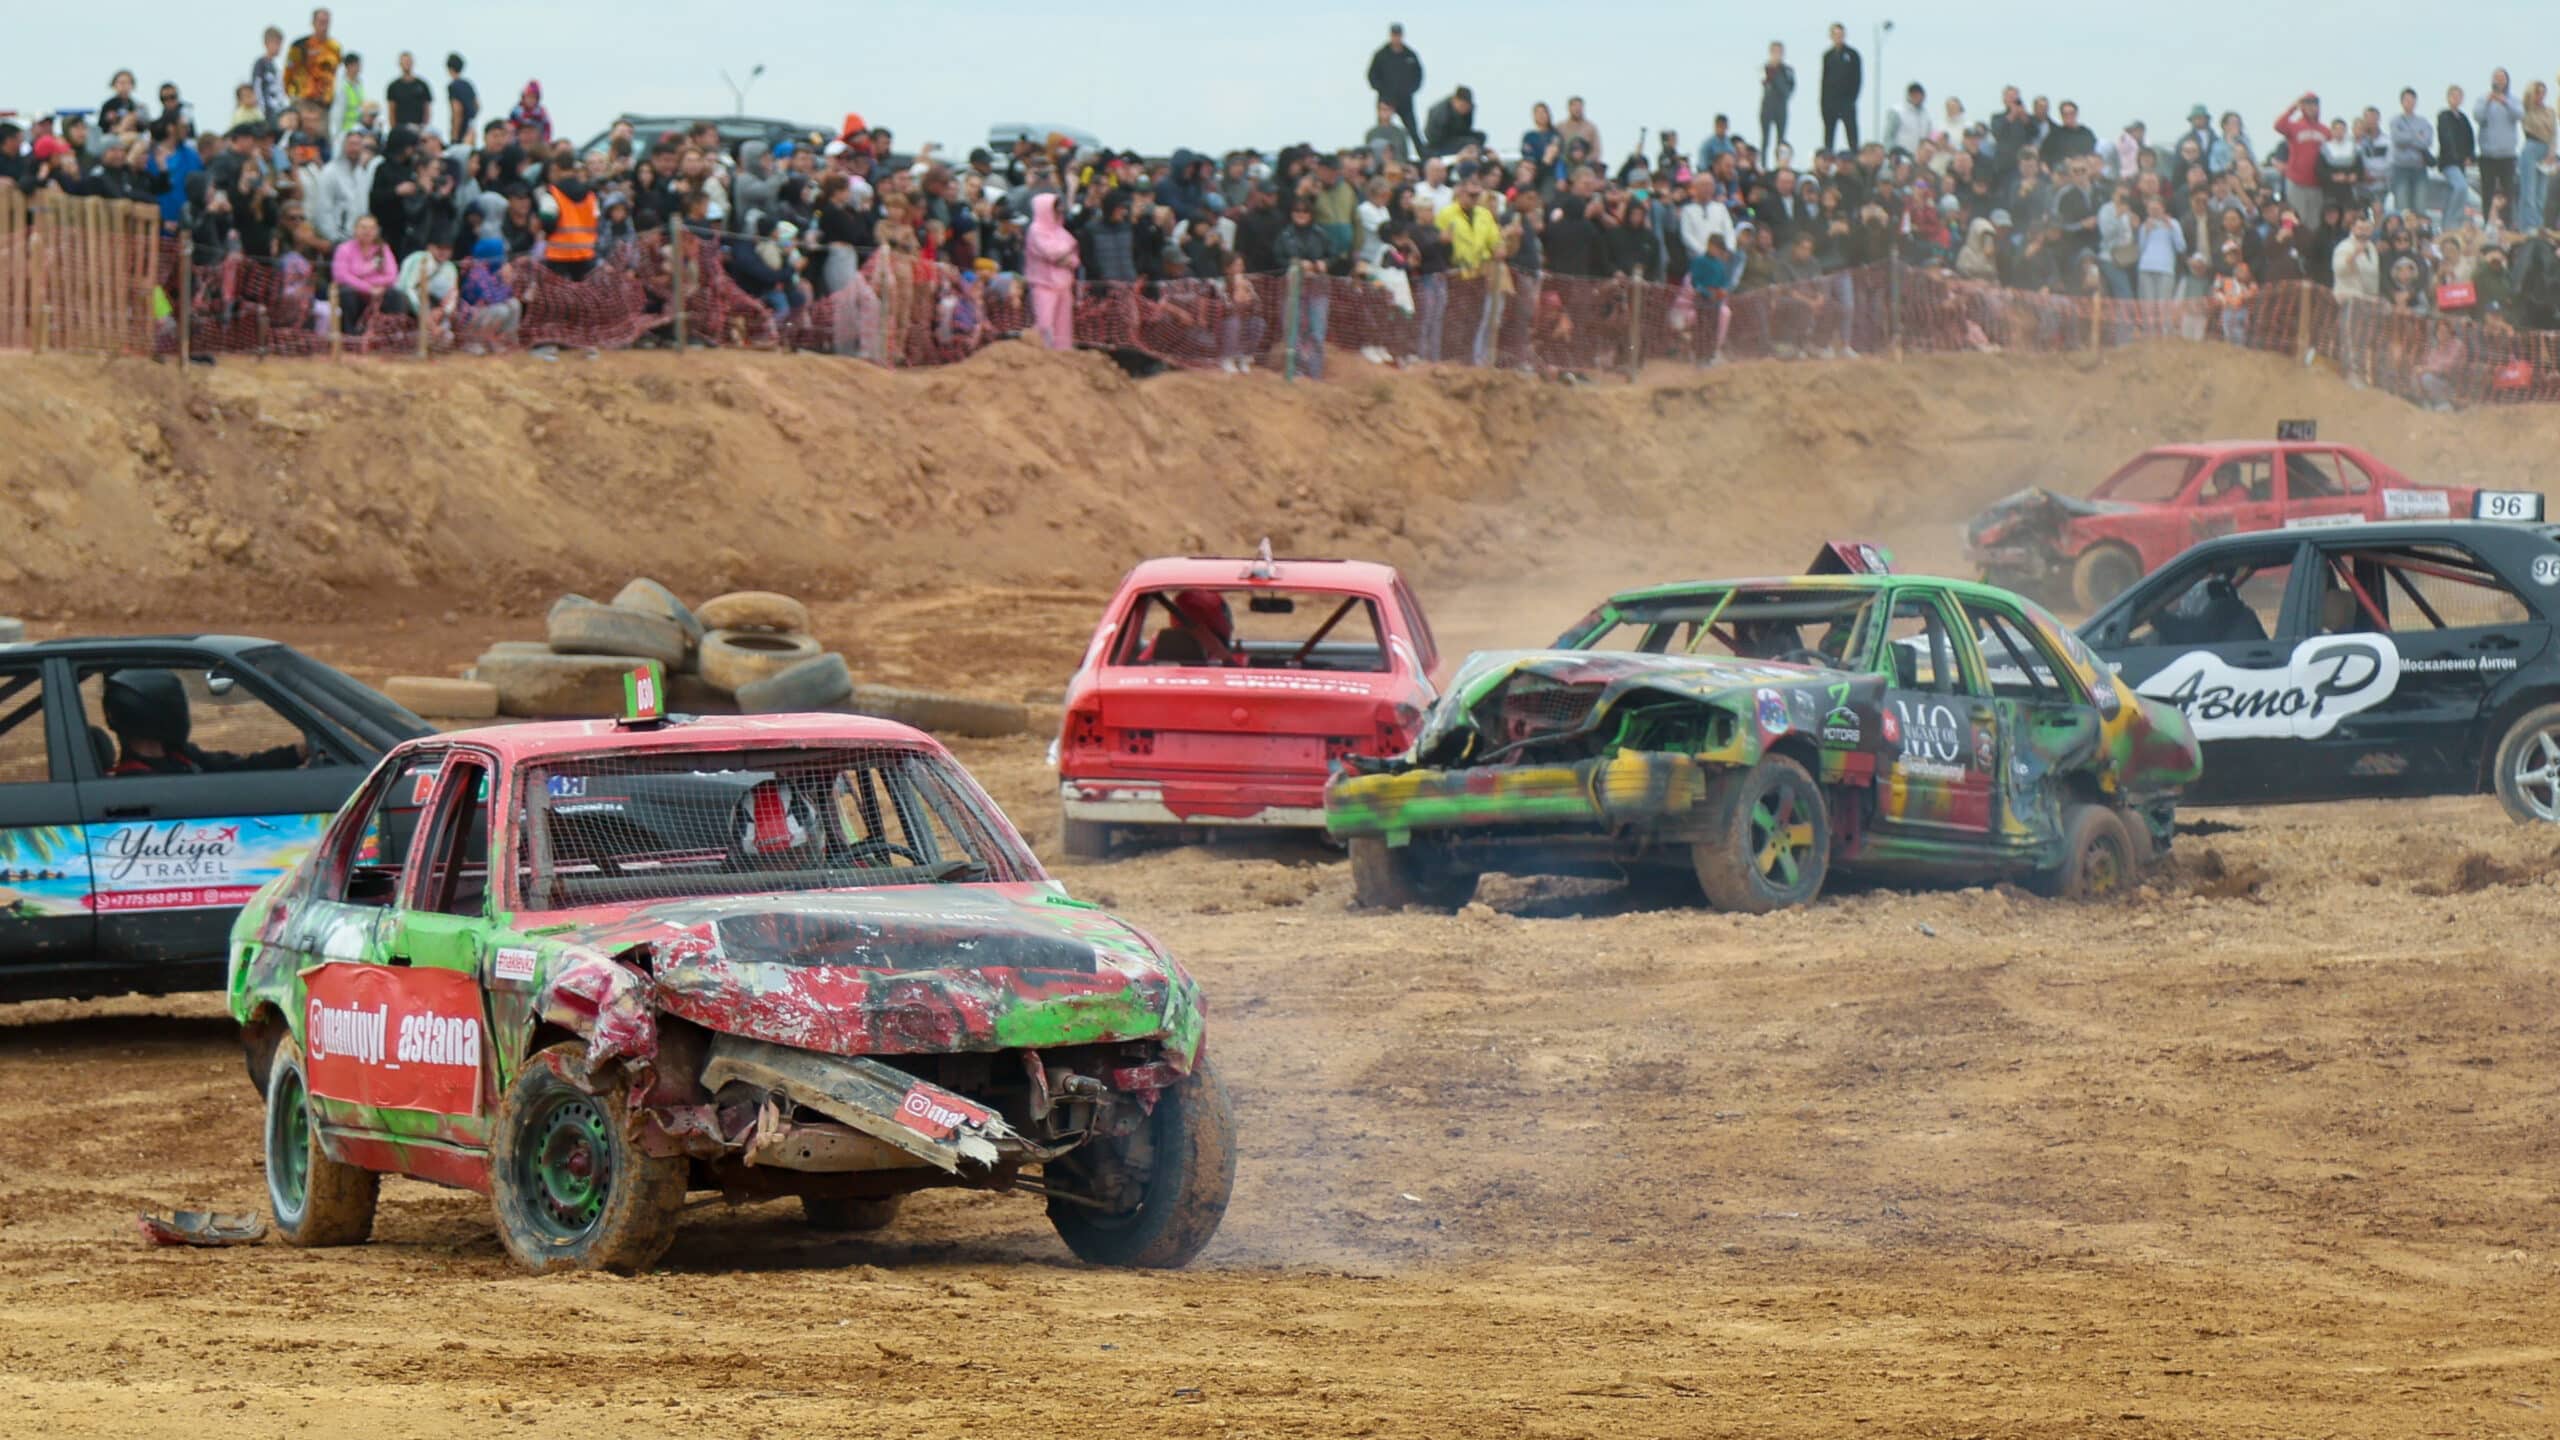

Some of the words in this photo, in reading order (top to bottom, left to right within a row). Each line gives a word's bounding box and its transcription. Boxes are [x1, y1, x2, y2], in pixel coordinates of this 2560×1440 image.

[2491, 495, 2522, 517] 96
[2535, 559, 2560, 577] 96
[2400, 658, 2476, 673] Москаленко
[2479, 655, 2517, 671] Антон
[104, 821, 235, 880] Yuliya
[141, 861, 229, 877] TRAVEL
